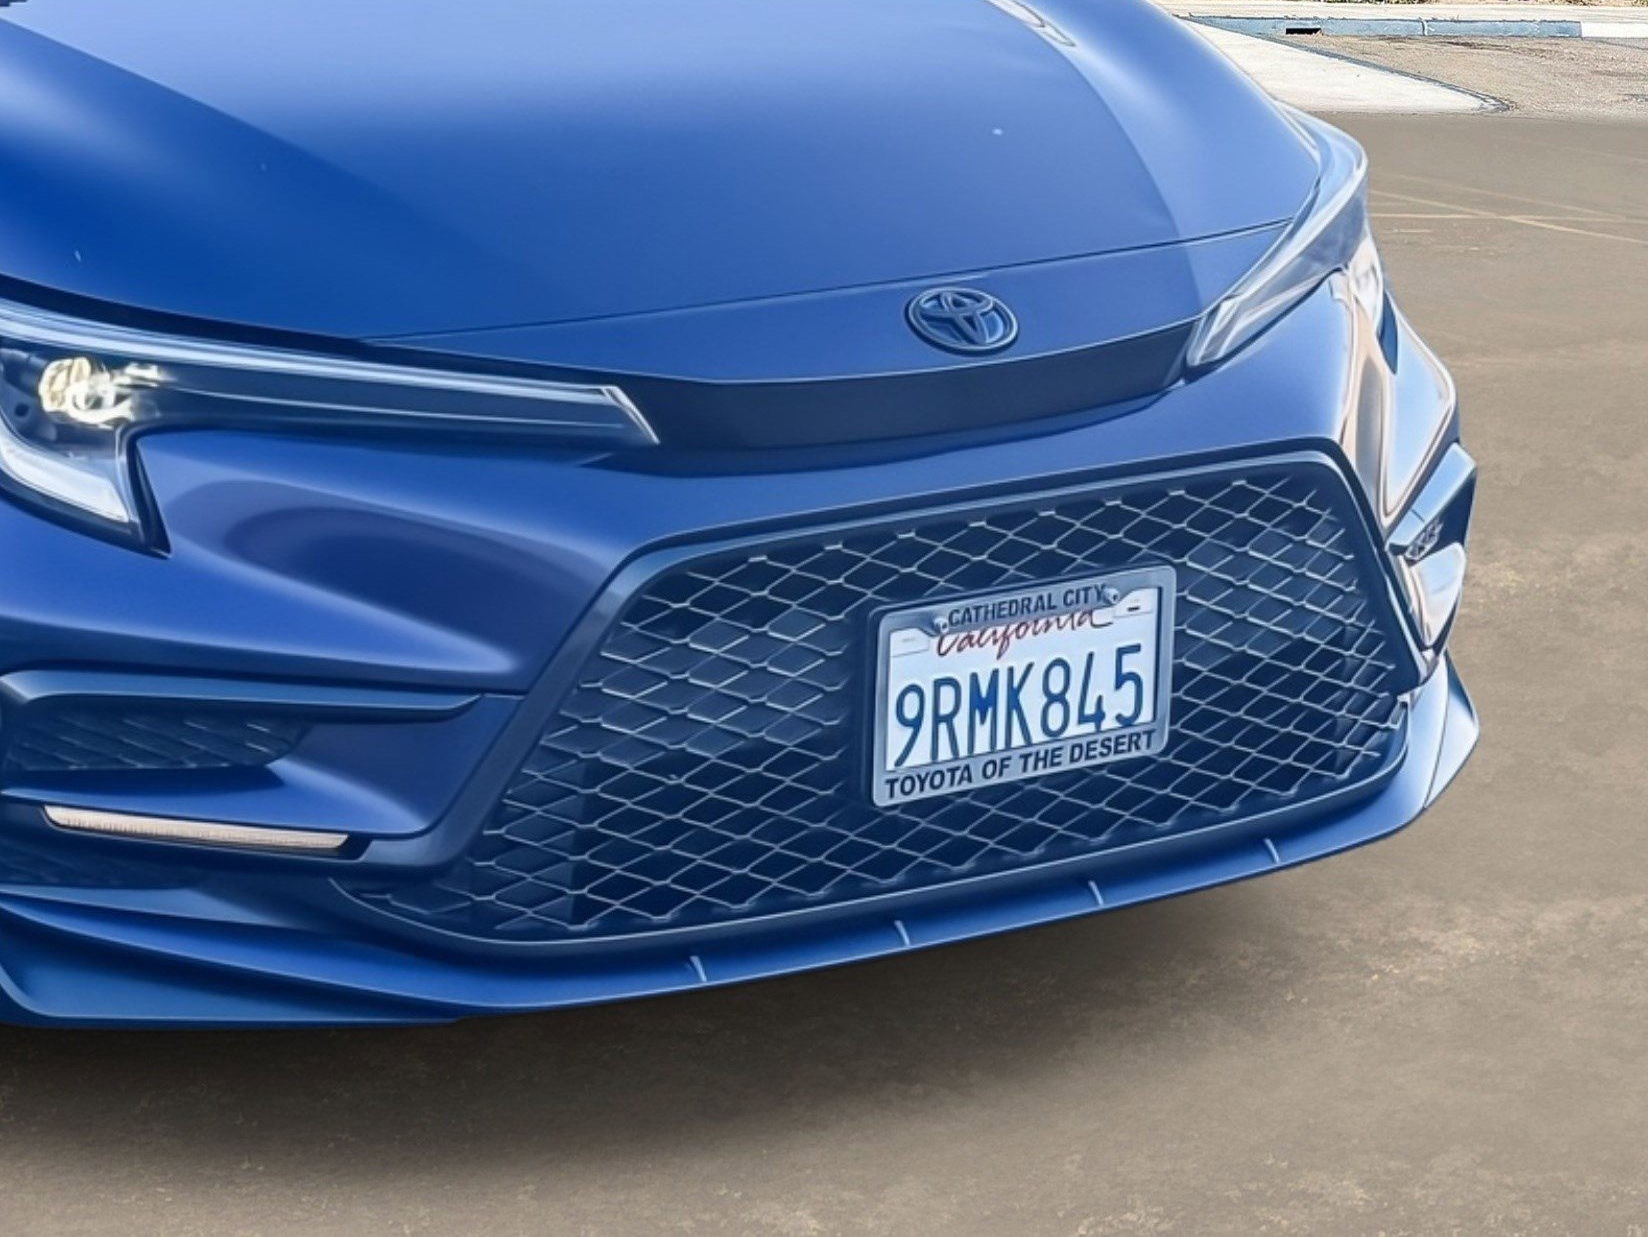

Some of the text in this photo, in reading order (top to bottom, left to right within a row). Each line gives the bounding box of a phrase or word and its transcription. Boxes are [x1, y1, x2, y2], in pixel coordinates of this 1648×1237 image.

[936, 609, 1114, 660] California
[947, 583, 1106, 627] CATHEDRAL CITY
[893, 643, 1144, 768] 9RMK845
[884, 729, 1156, 799] TOYOTA OF THE DESERT
